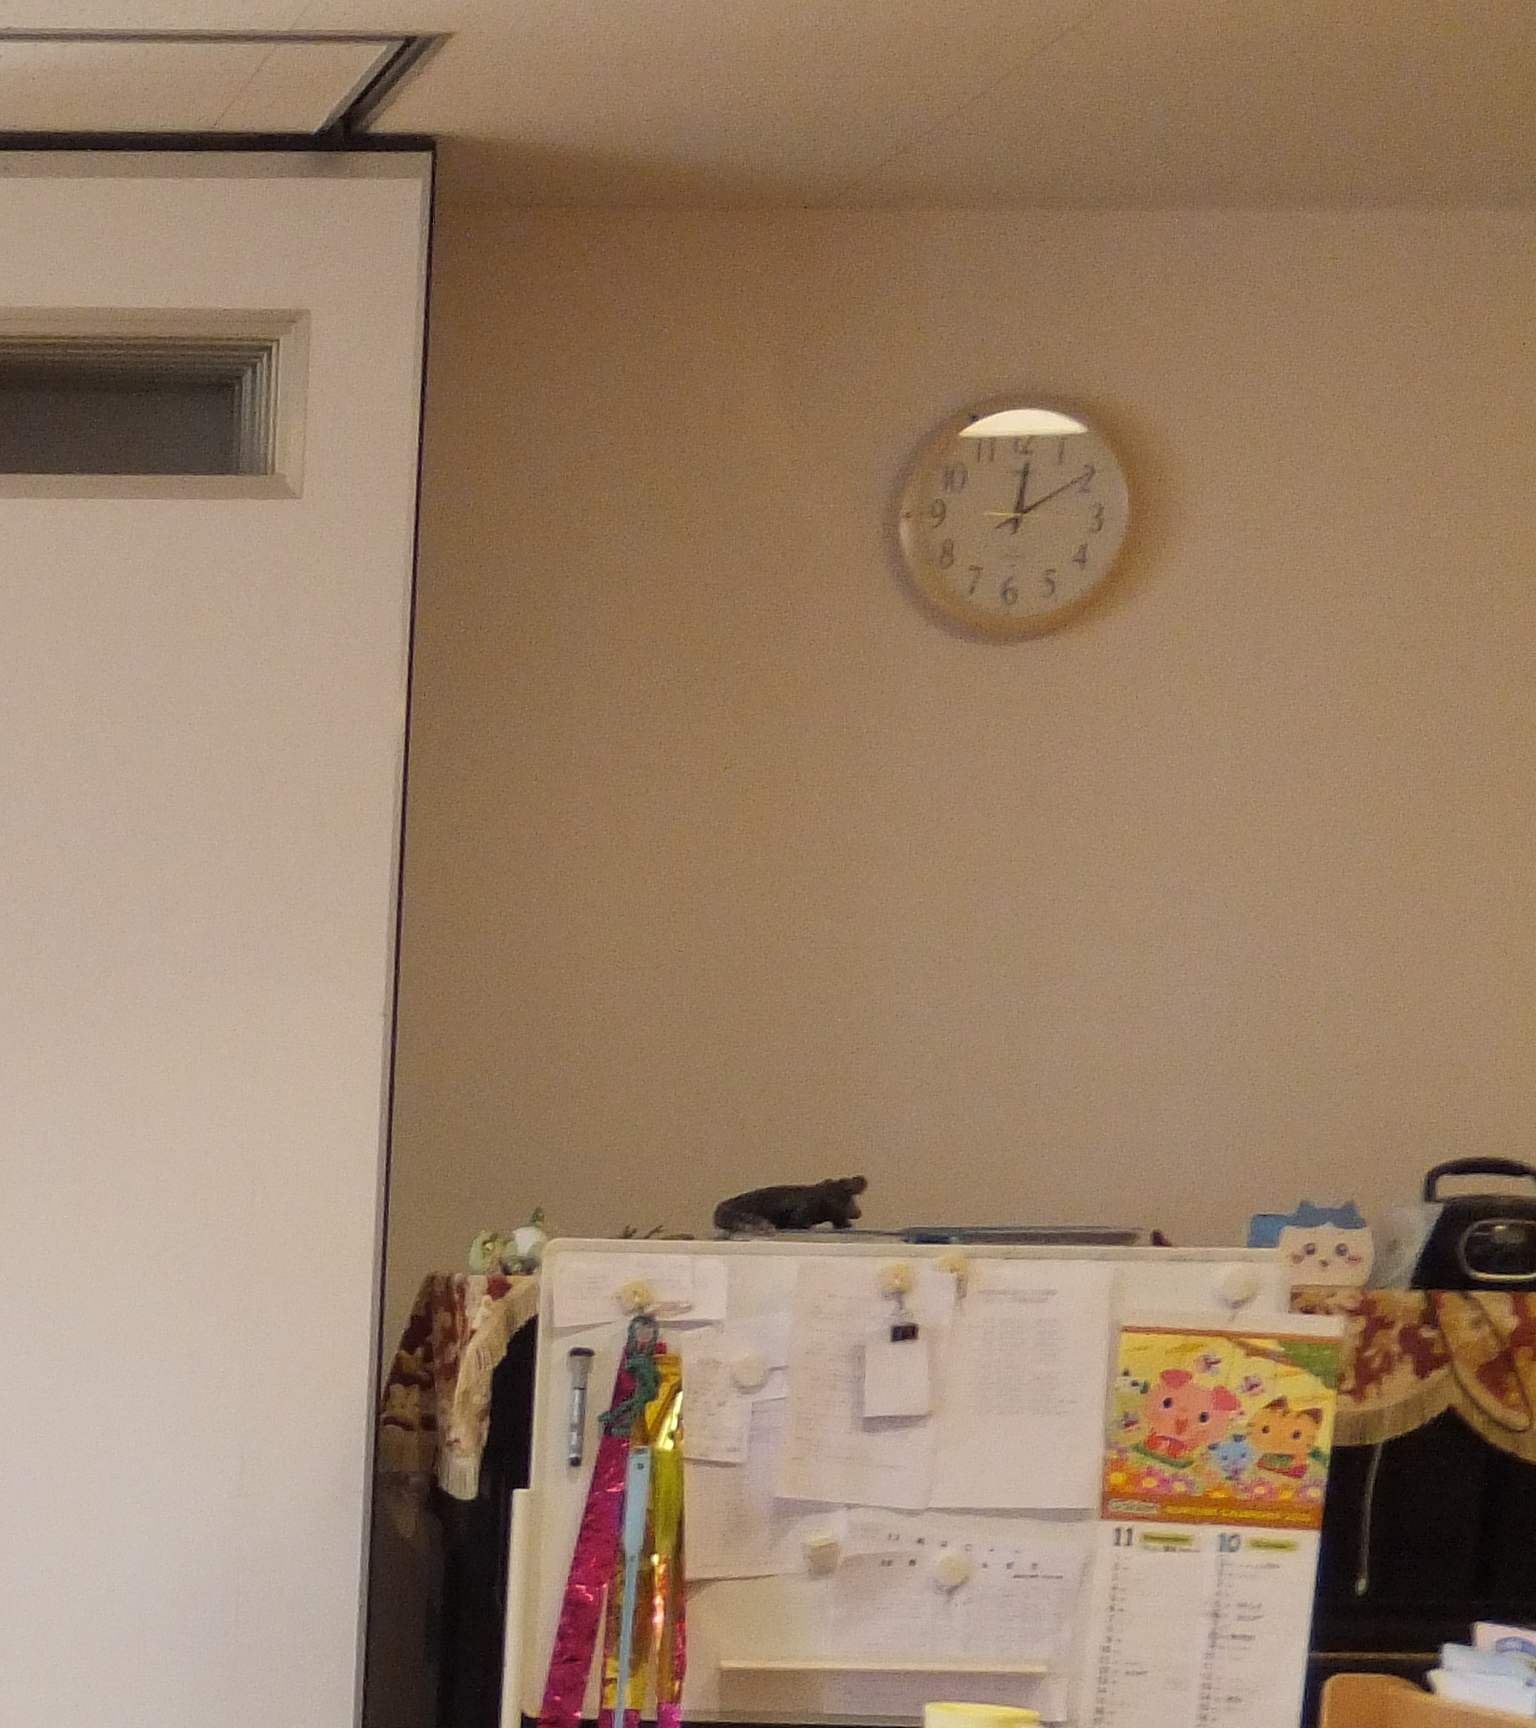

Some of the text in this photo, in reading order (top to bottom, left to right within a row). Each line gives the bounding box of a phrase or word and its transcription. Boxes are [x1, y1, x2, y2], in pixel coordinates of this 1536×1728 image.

[942, 462, 968, 493] 10
[930, 498, 947, 529] 9
[1089, 501, 1106, 534] 3
[939, 537, 955, 569] 8
[1072, 543, 1088, 570] 4
[968, 566, 983, 595] 7
[999, 576, 1019, 605] 6
[1042, 568, 1056, 598] 5
[1112, 1526, 1134, 1547] 11
[1218, 1531, 1242, 1554] 10
